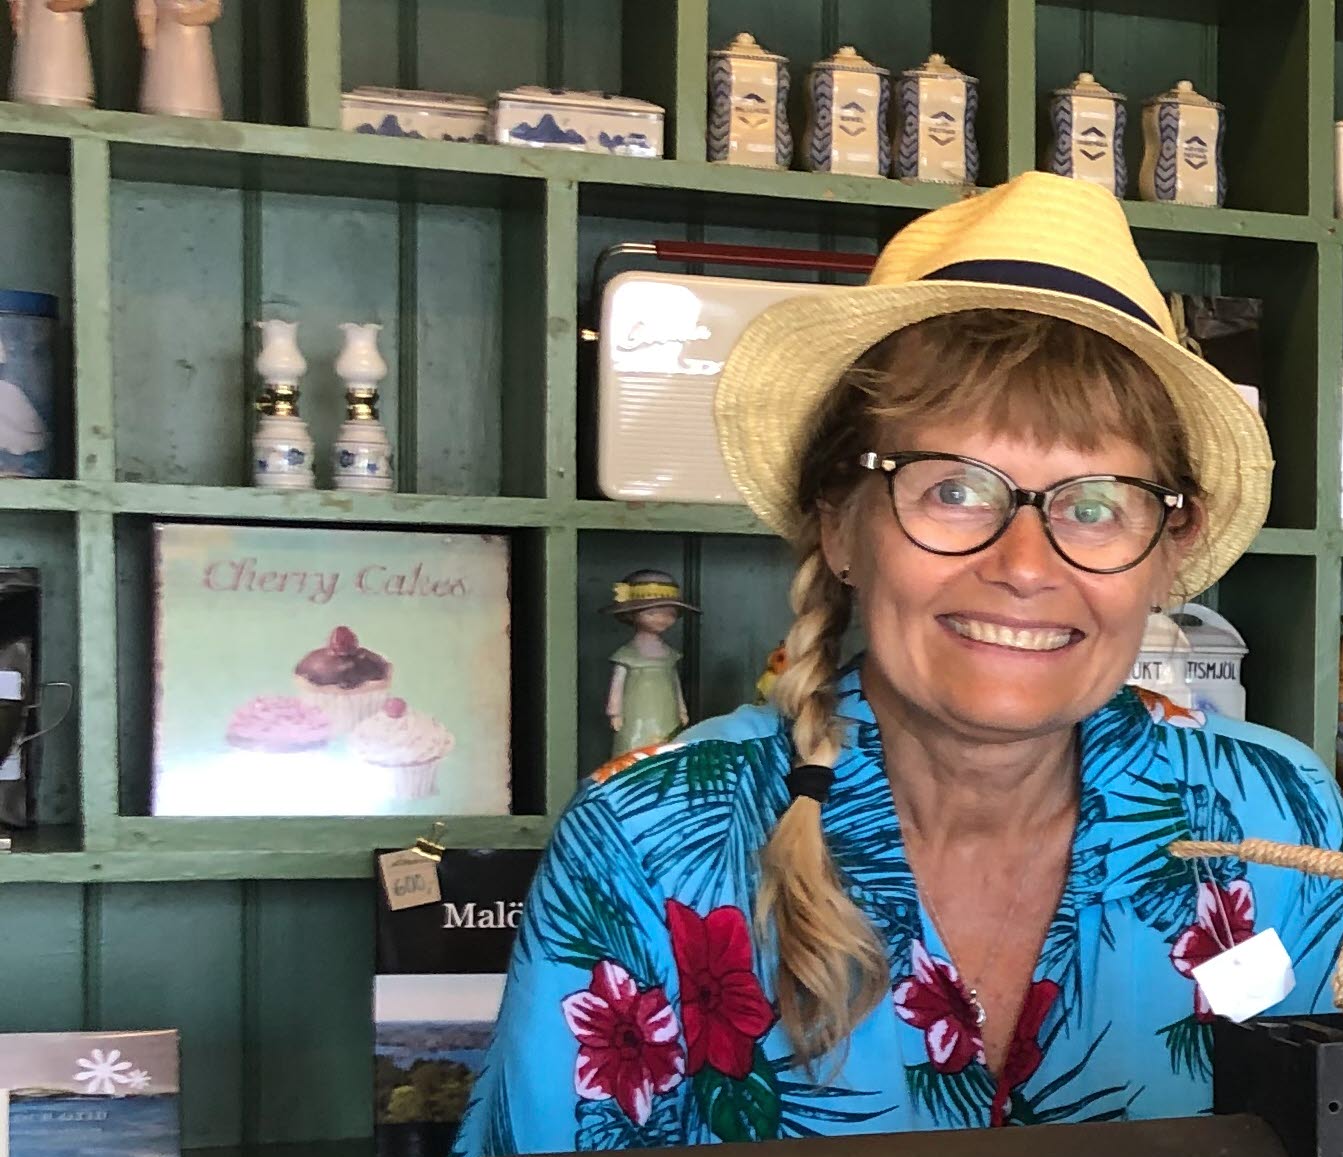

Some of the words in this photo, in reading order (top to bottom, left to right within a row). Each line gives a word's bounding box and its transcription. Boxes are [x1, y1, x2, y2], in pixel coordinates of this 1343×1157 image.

[203, 556, 340, 605] Cherry
[356, 561, 467, 599] Cakes
[1132, 661, 1163, 680] UKT
[1186, 661, 1237, 680] TISMJÖL
[441, 901, 524, 929] Malö
